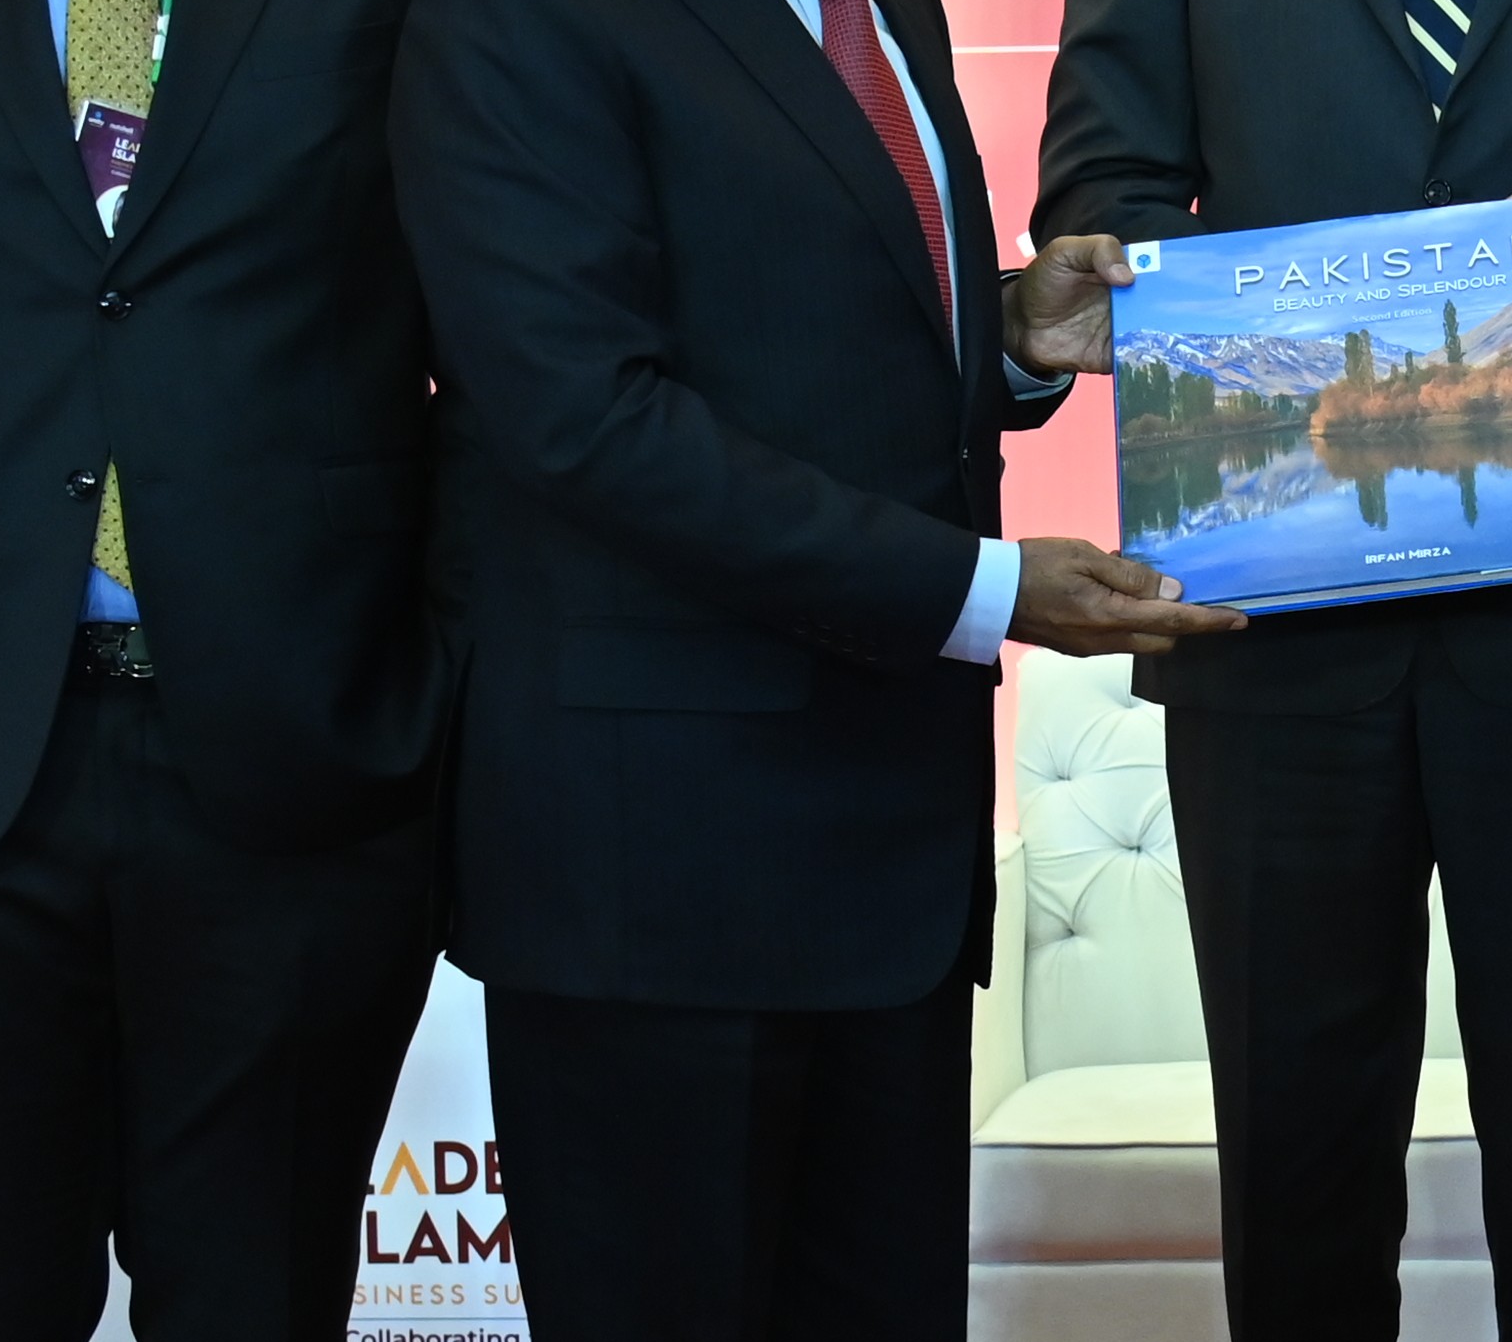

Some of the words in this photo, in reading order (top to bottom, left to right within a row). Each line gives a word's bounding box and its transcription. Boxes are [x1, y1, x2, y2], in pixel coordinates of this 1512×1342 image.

[1273, 293, 1346, 312] BEAUTY
[1354, 287, 1392, 304] AND
[1398, 272, 1507, 298] SPLENDOUR
